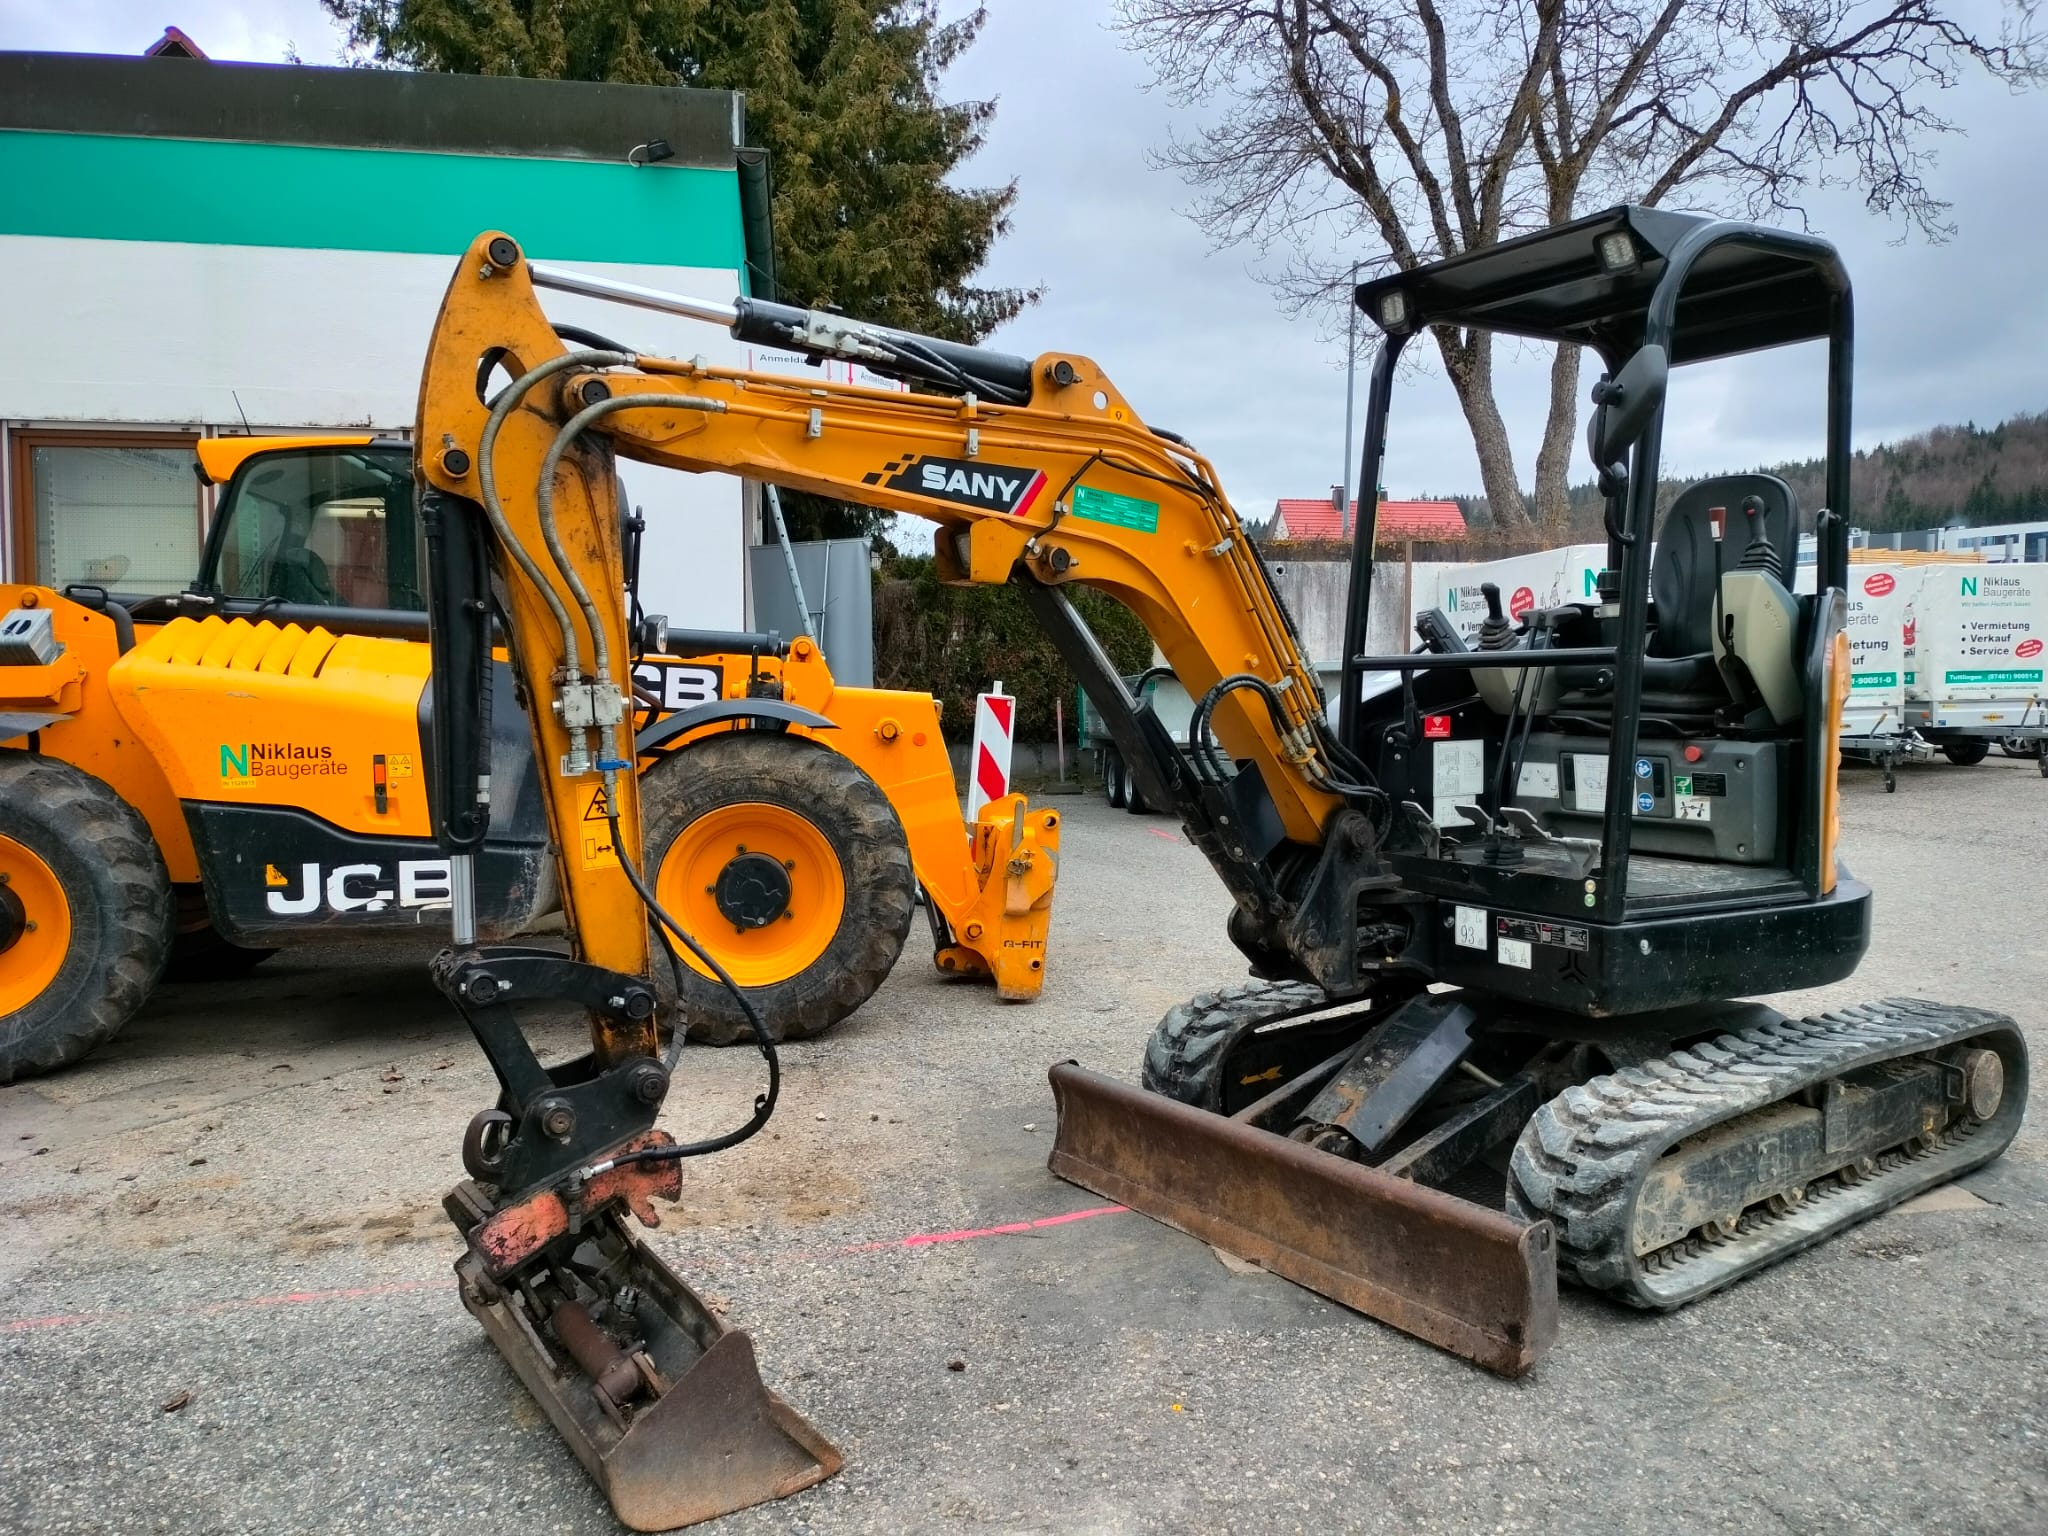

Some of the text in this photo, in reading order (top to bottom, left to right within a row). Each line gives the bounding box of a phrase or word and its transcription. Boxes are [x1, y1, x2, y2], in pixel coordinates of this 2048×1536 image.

[760, 353, 807, 364] Anmeldu
[860, 371, 895, 390] Anmeldung
[922, 463, 1021, 502] SANY
[1077, 488, 1085, 498] N
[1961, 576, 1977, 596] N
[1983, 577, 2021, 586] Niklaus
[1448, 588, 1457, 612] N
[1983, 587, 2031, 599] Baugeräte
[1847, 613, 1879, 625] eräte
[1970, 622, 2030, 631] Vermietung
[1849, 640, 1889, 651] ietung
[1970, 634, 2011, 642] Verkauf
[1969, 647, 2010, 655] Service
[631, 664, 719, 709] CB
[220, 743, 248, 777] N
[251, 743, 332, 760] Niklaus
[251, 760, 348, 780] Baugeräte
[266, 860, 452, 914] JCB
[1460, 924, 1475, 945] 93
